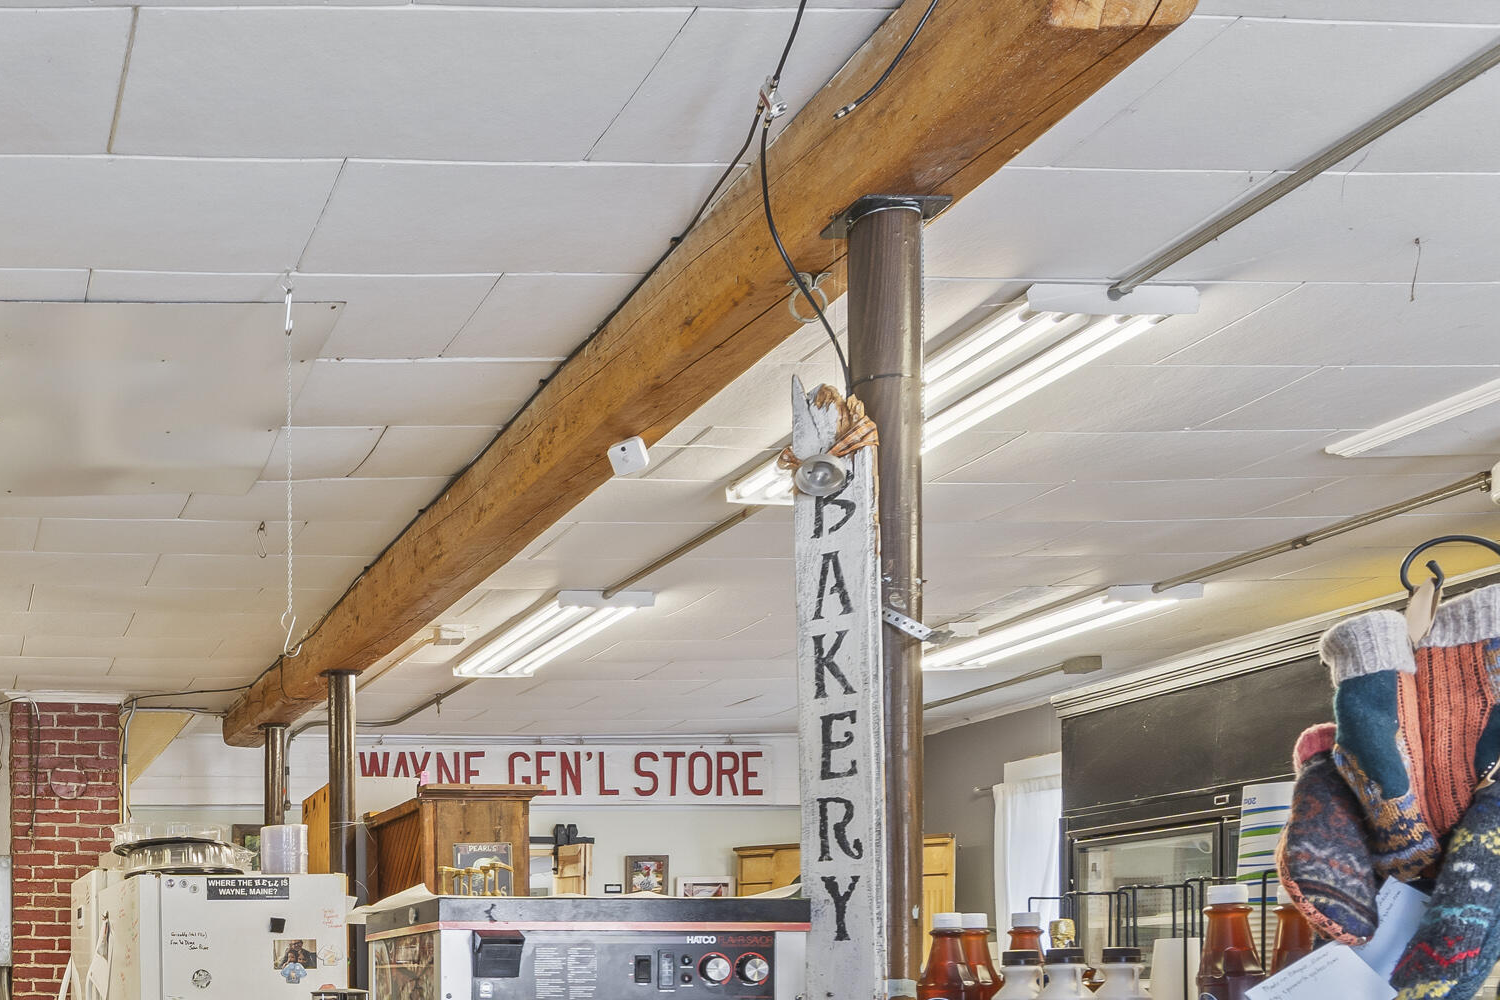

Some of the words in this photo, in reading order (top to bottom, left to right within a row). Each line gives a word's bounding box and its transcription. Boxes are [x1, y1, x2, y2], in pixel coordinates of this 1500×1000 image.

[358, 751, 485, 785] WAYNE
[634, 751, 763, 796] STORE
[208, 879, 236, 887] WHERE
[238, 879, 253, 887] THE
[254, 878, 280, 888] HELL
[280, 879, 288, 887] IS
[218, 888, 248, 896] WAYNE,
[686, 935, 716, 944] HATCO
